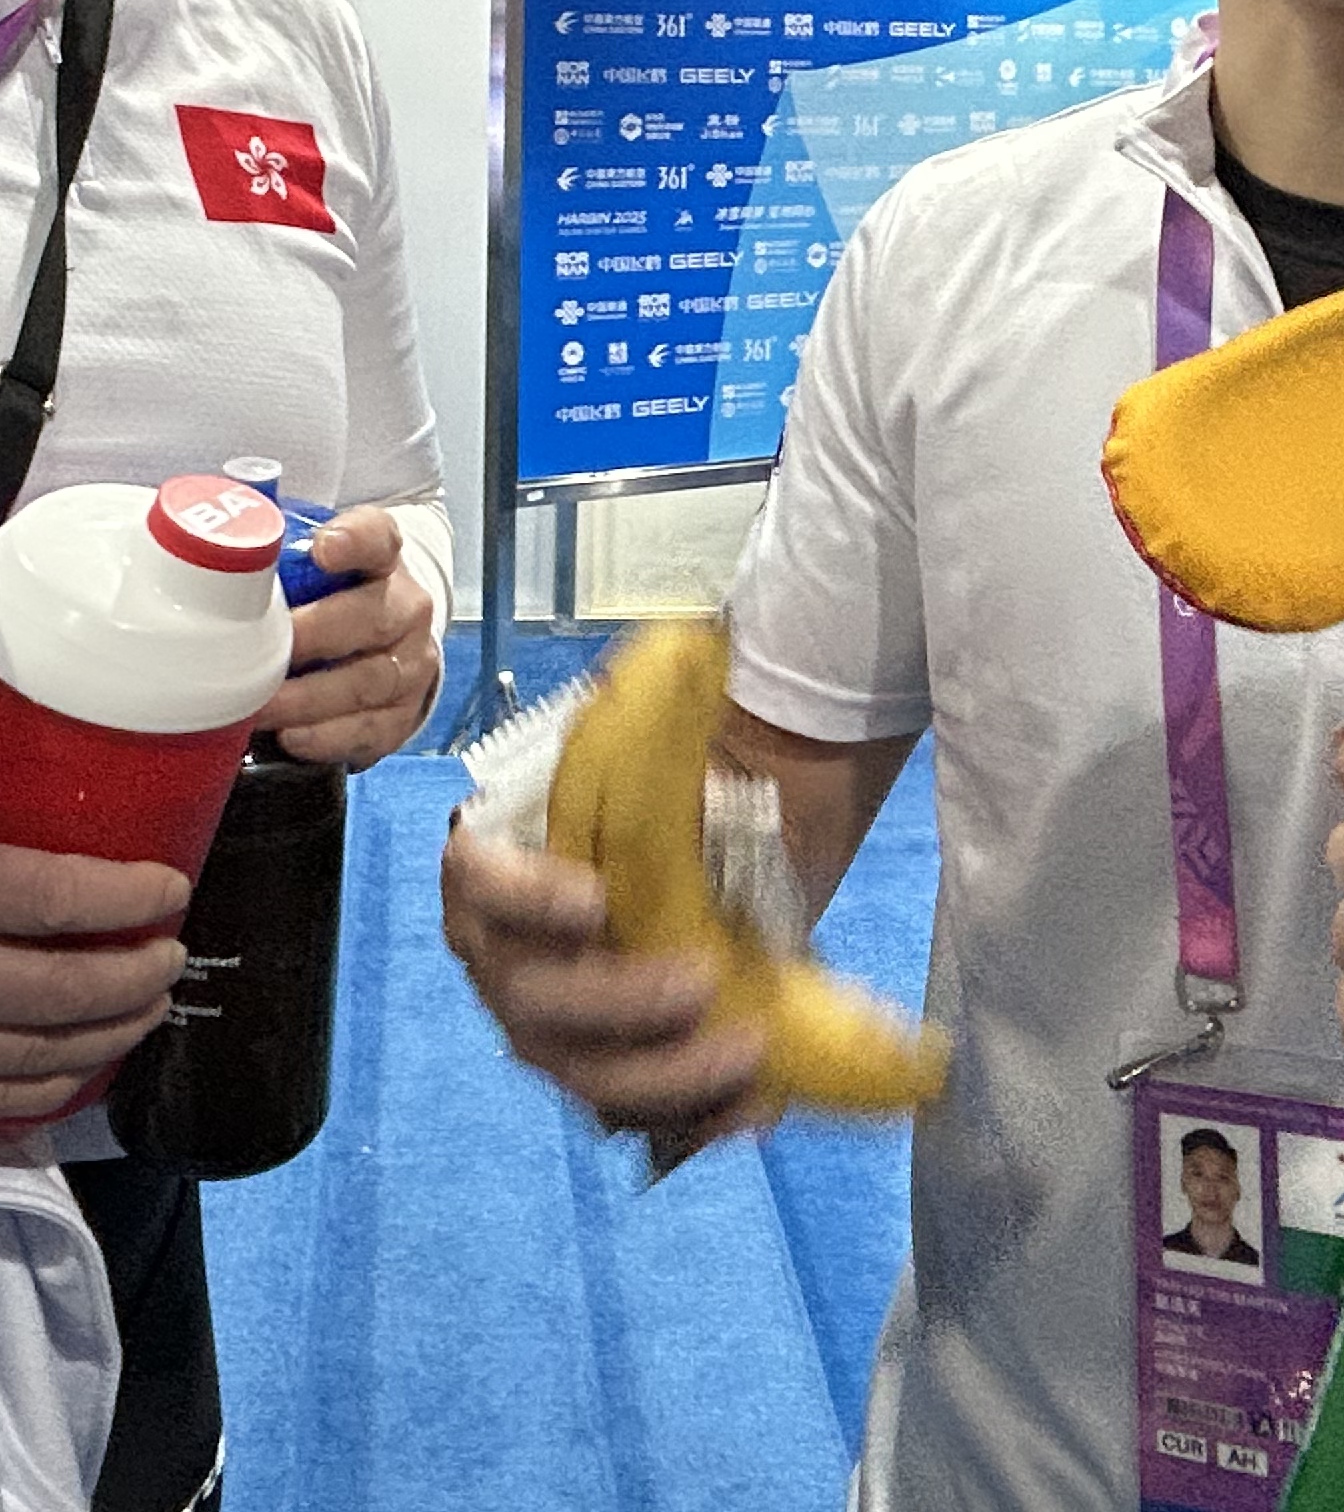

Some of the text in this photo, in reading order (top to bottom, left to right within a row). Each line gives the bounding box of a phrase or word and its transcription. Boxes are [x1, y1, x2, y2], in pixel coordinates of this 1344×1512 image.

[889, 21, 956, 38] GEELY
[680, 68, 756, 84] GEELY
[658, 163, 696, 189] 361°
[669, 250, 744, 270] GEELY
[746, 291, 820, 310] GEELY
[631, 396, 710, 418] GEELY
[1227, 1448, 1257, 1471] AH
